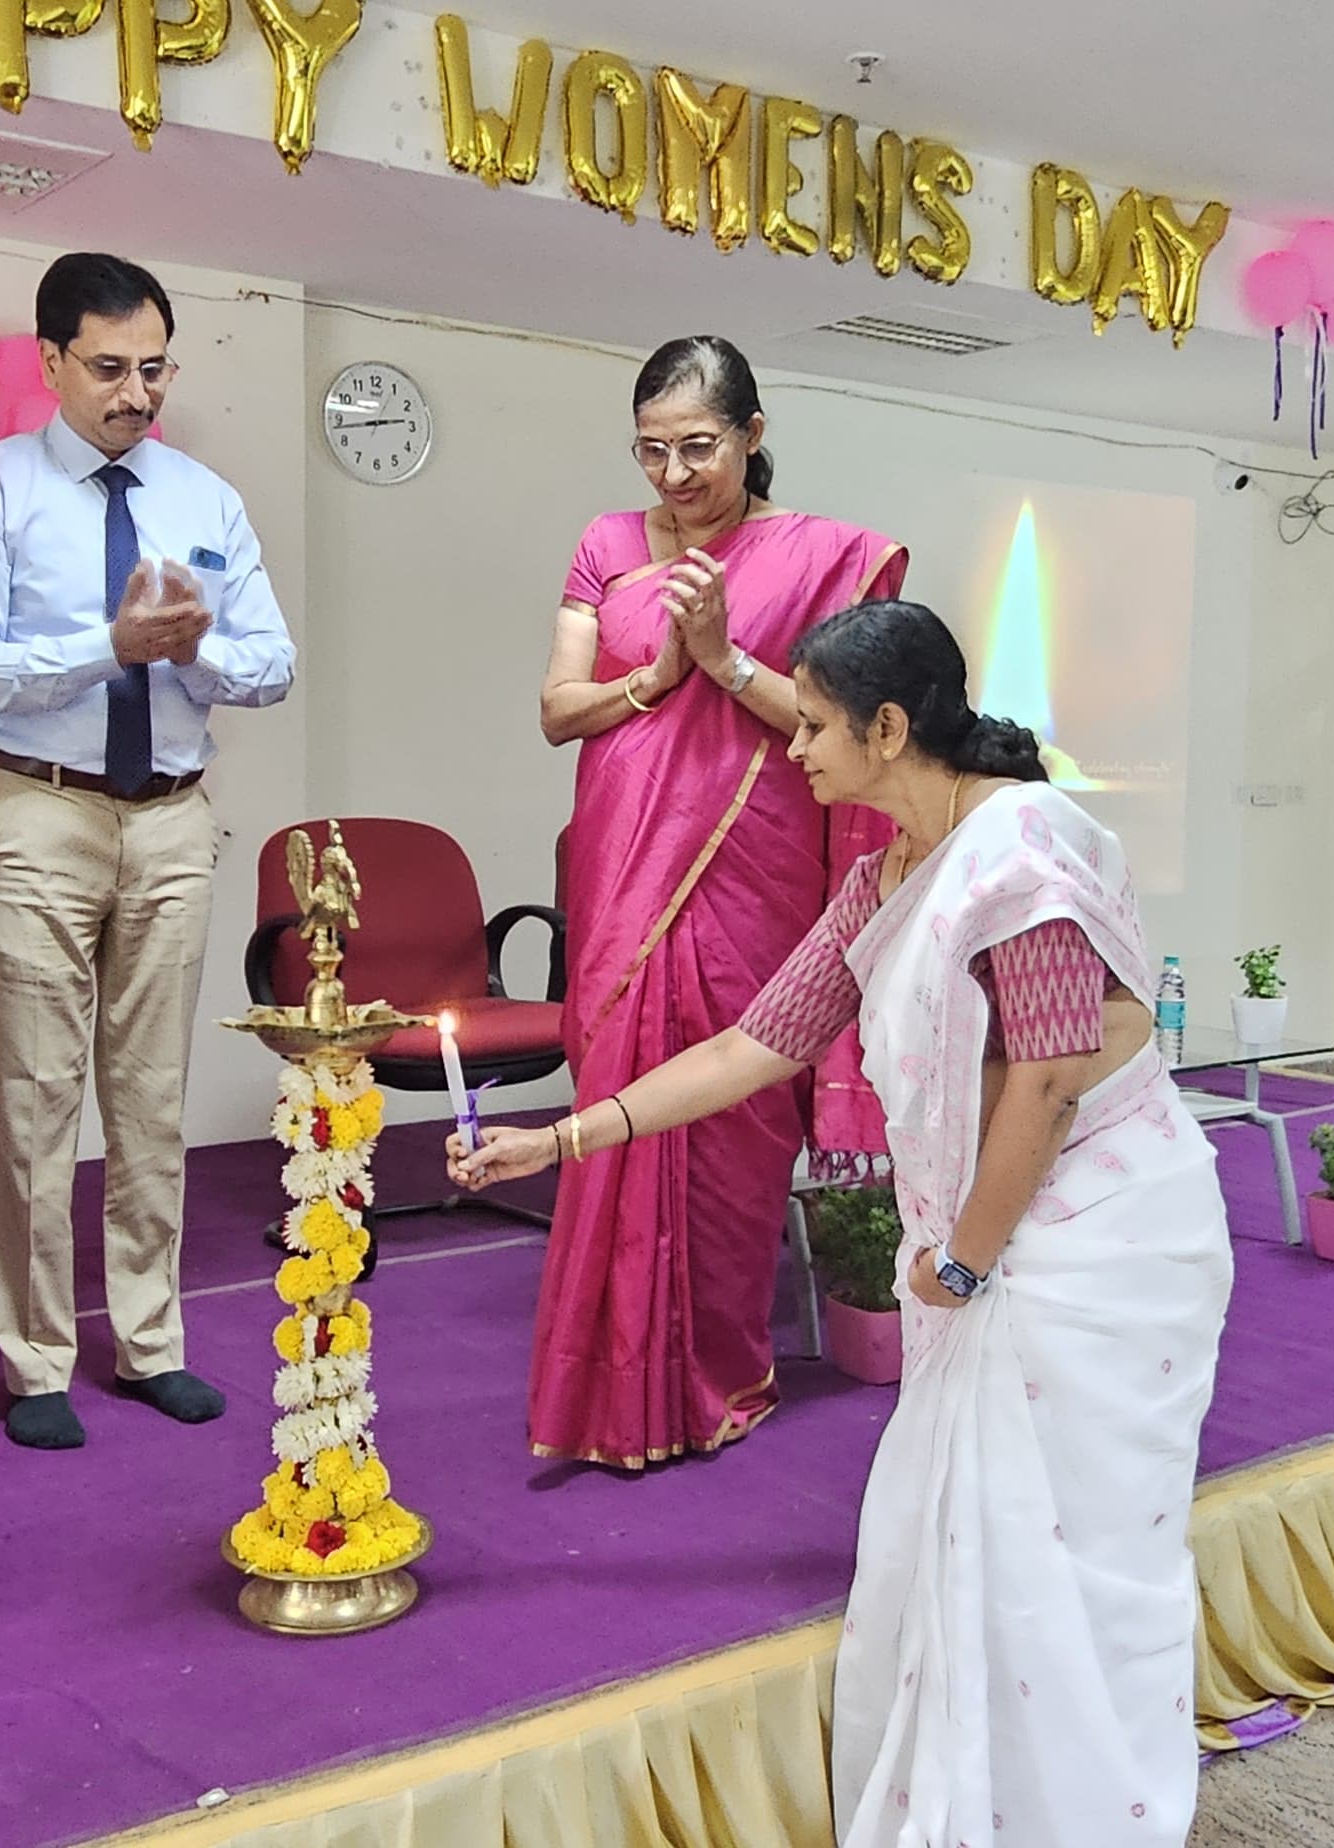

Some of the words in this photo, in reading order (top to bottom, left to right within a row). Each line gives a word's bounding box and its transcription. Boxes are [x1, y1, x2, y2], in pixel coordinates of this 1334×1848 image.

[434, 13, 973, 286] WOMENS
[1032, 162, 1231, 349] DAY
[353, 379, 363, 392] 11
[370, 375, 382, 389] 12
[404, 400, 411, 412] 2
[409, 421, 416, 433] 3
[341, 434, 348, 447] 8
[354, 451, 362, 464] 7
[391, 454, 399, 467] 5
[373, 459, 381, 471] 6
